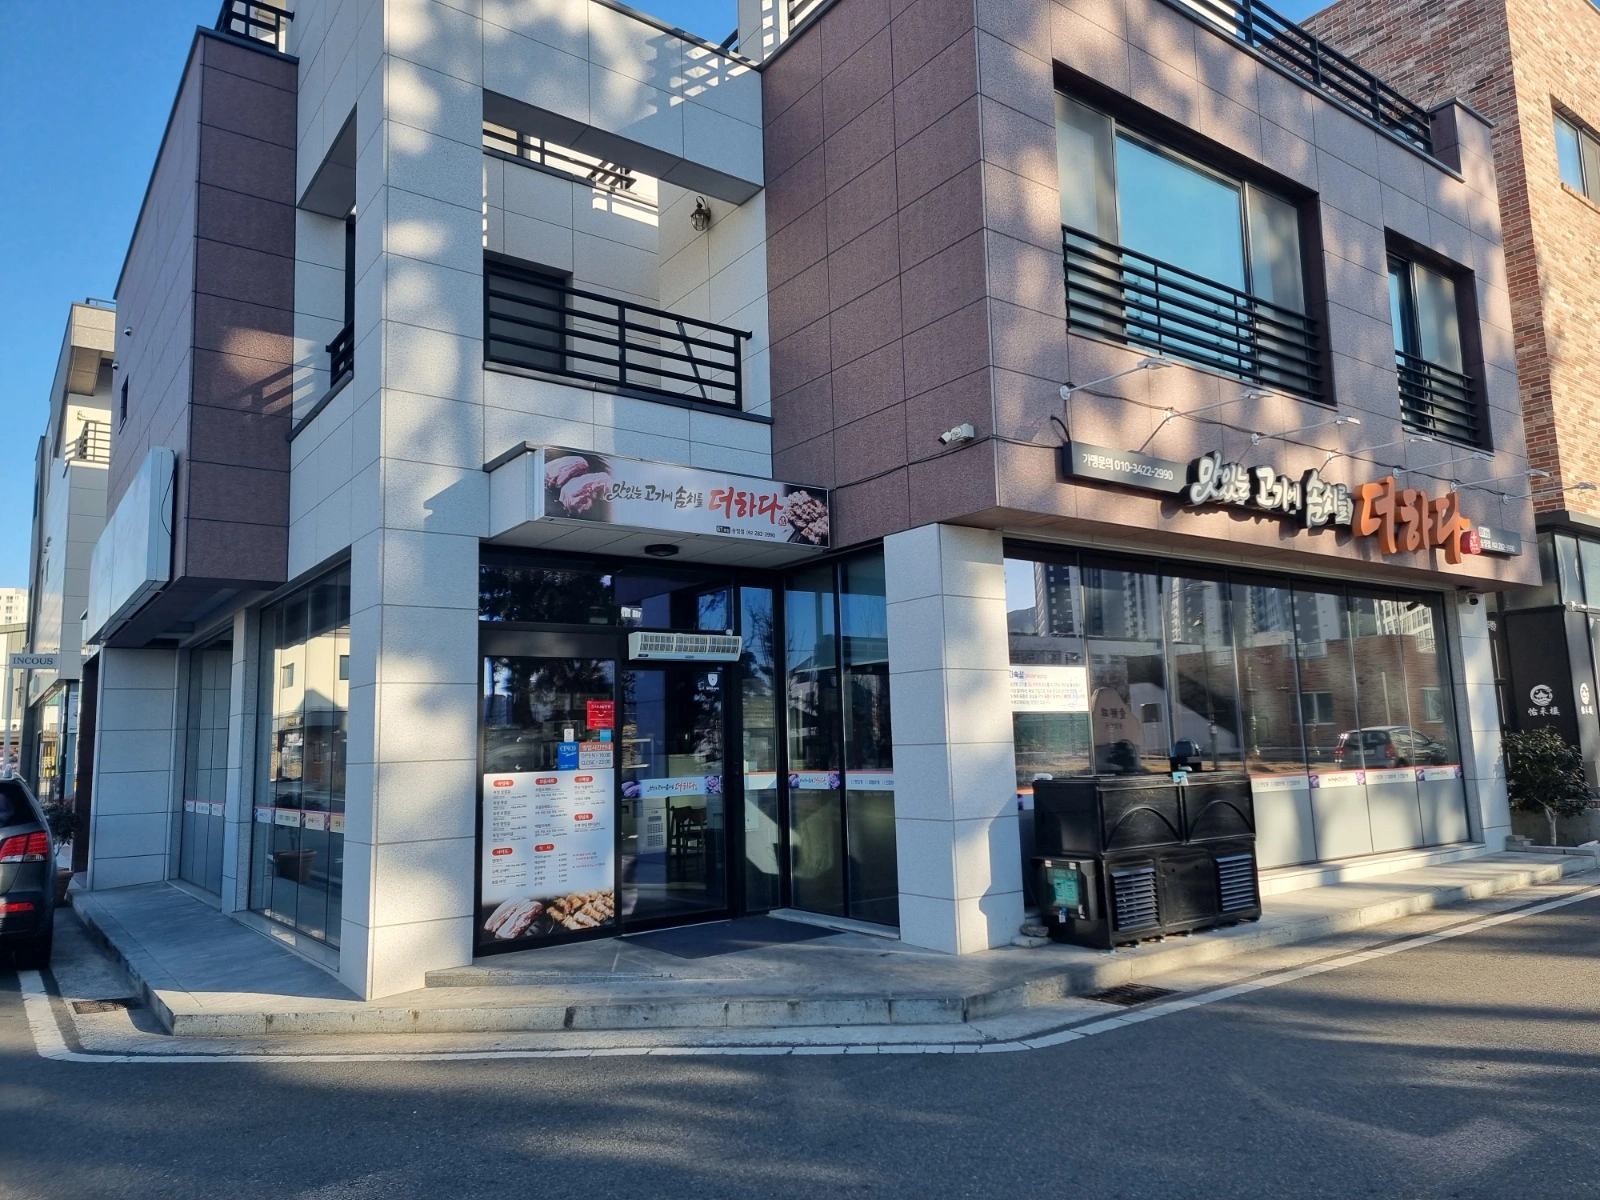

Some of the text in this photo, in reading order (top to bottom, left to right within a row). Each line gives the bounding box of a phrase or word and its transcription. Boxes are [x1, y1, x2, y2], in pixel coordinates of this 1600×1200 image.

[1082, 453, 1174, 481] 가맹문의 010-3422-2990
[606, 481, 642, 501] 맛있는
[644, 484, 673, 502] 고기에
[673, 485, 704, 509] 솜씨를
[708, 486, 784, 525] 더하다
[1190, 450, 1250, 505] 맛있는
[1255, 465, 1302, 512] 고기에
[1306, 469, 1353, 528] 솜씨를
[1360, 475, 1471, 564] 더하다
[13, 657, 54, 665] INCOUS
